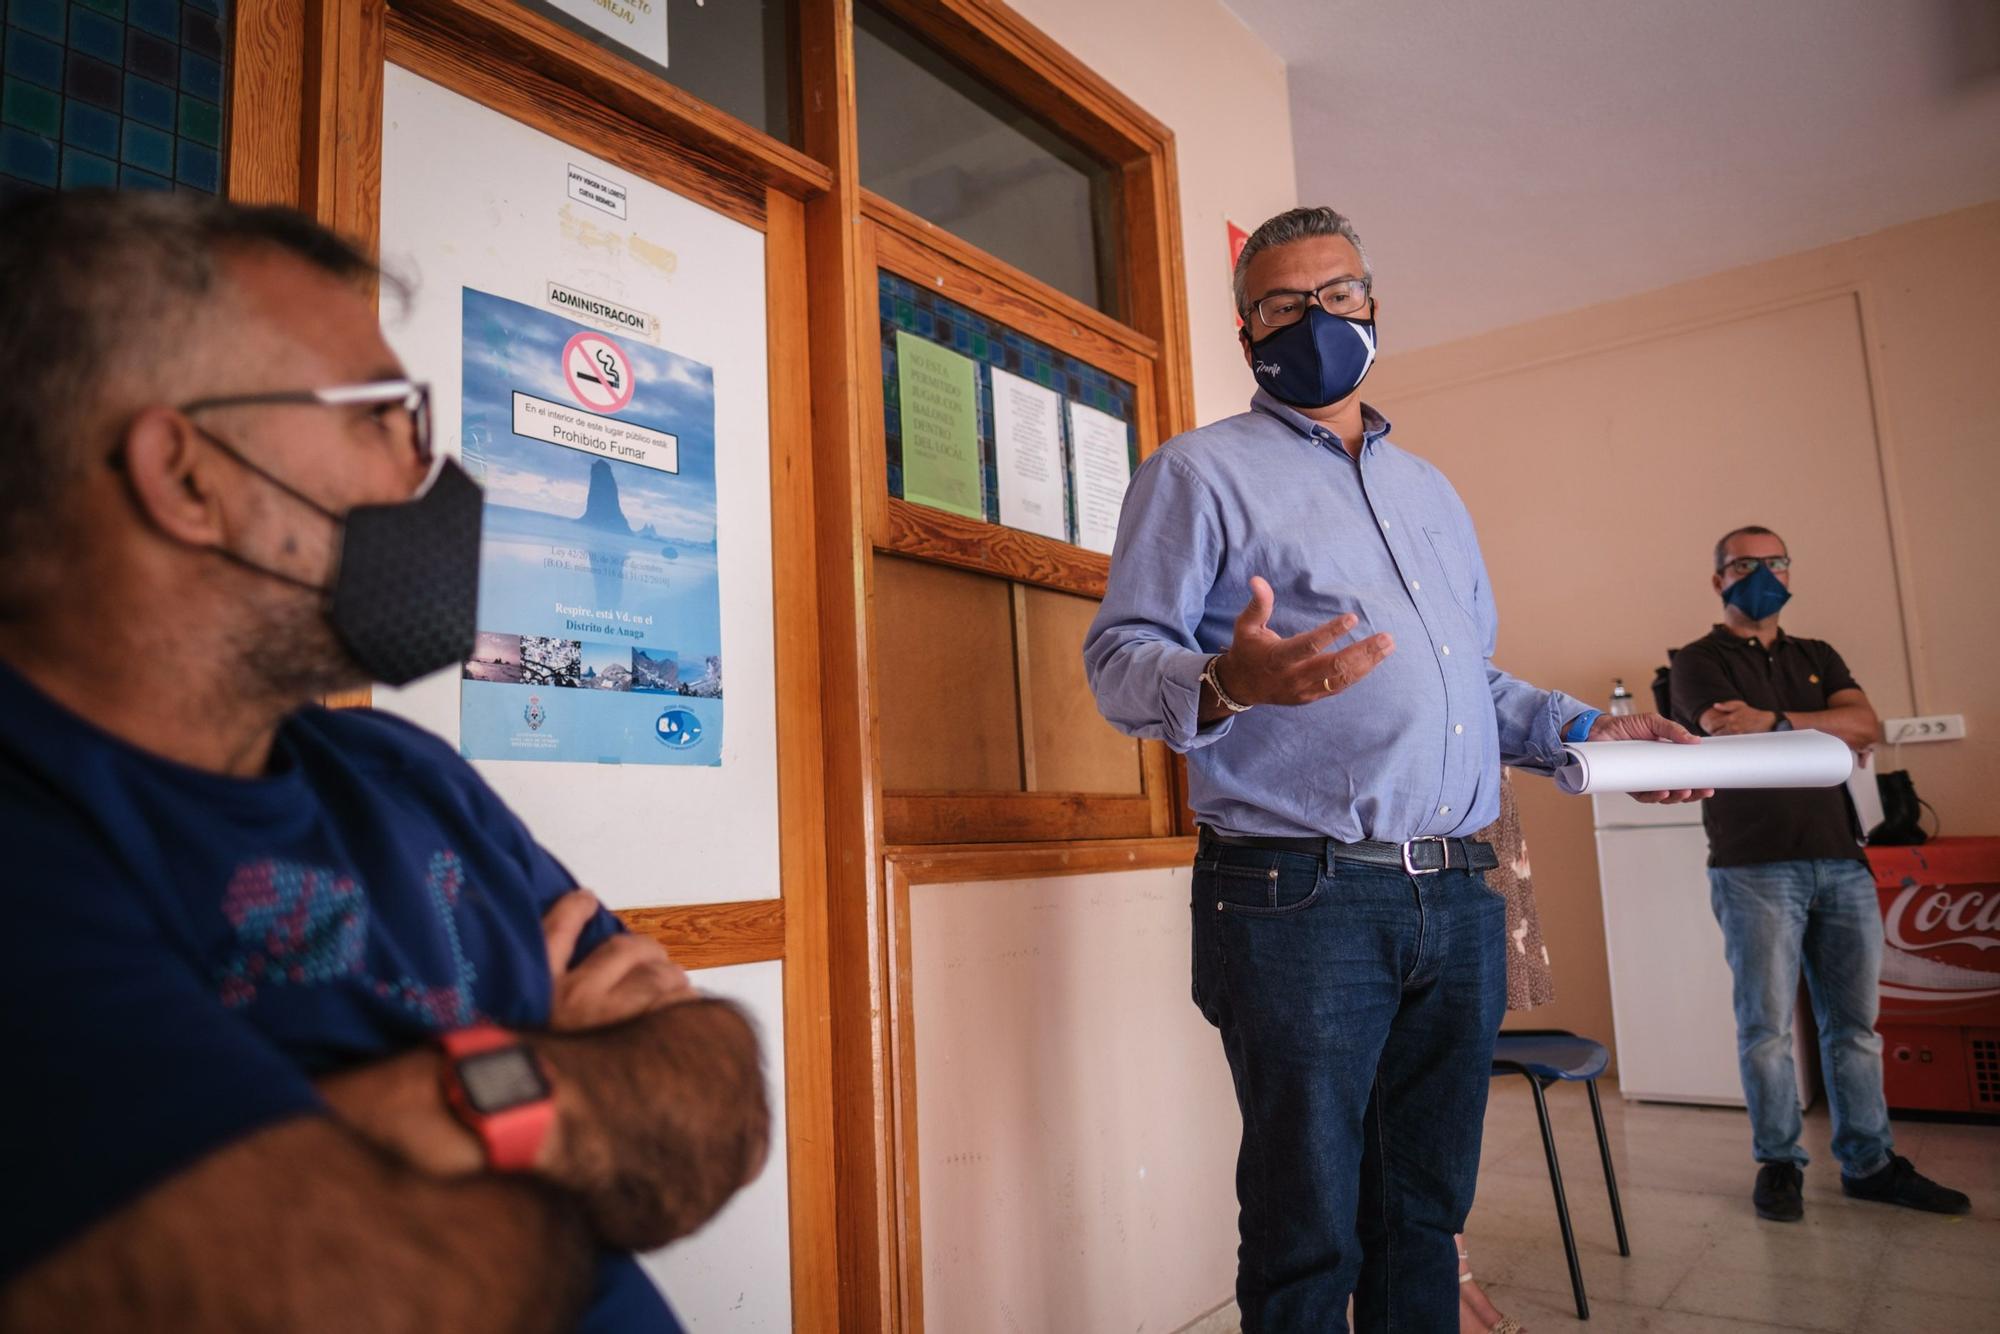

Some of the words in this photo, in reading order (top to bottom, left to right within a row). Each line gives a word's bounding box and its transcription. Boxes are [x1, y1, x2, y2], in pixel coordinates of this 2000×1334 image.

[551, 289, 645, 329] ADMINISTRACION
[525, 402, 537, 412] En
[538, 407, 546, 416] el
[548, 410, 574, 423] interior
[576, 418, 585, 427] de
[587, 422, 603, 432] este
[604, 425, 624, 437] lugar
[553, 425, 606, 451] Prohibido
[611, 440, 645, 460] Fumar
[555, 602, 593, 618] Respire,
[596, 607, 613, 620] está
[615, 610, 631, 622] Vd.
[633, 615, 643, 624] en
[645, 615, 653, 625] el
[566, 620, 602, 634] Distrito
[604, 625, 614, 635] de
[617, 627, 644, 640] Anaga
